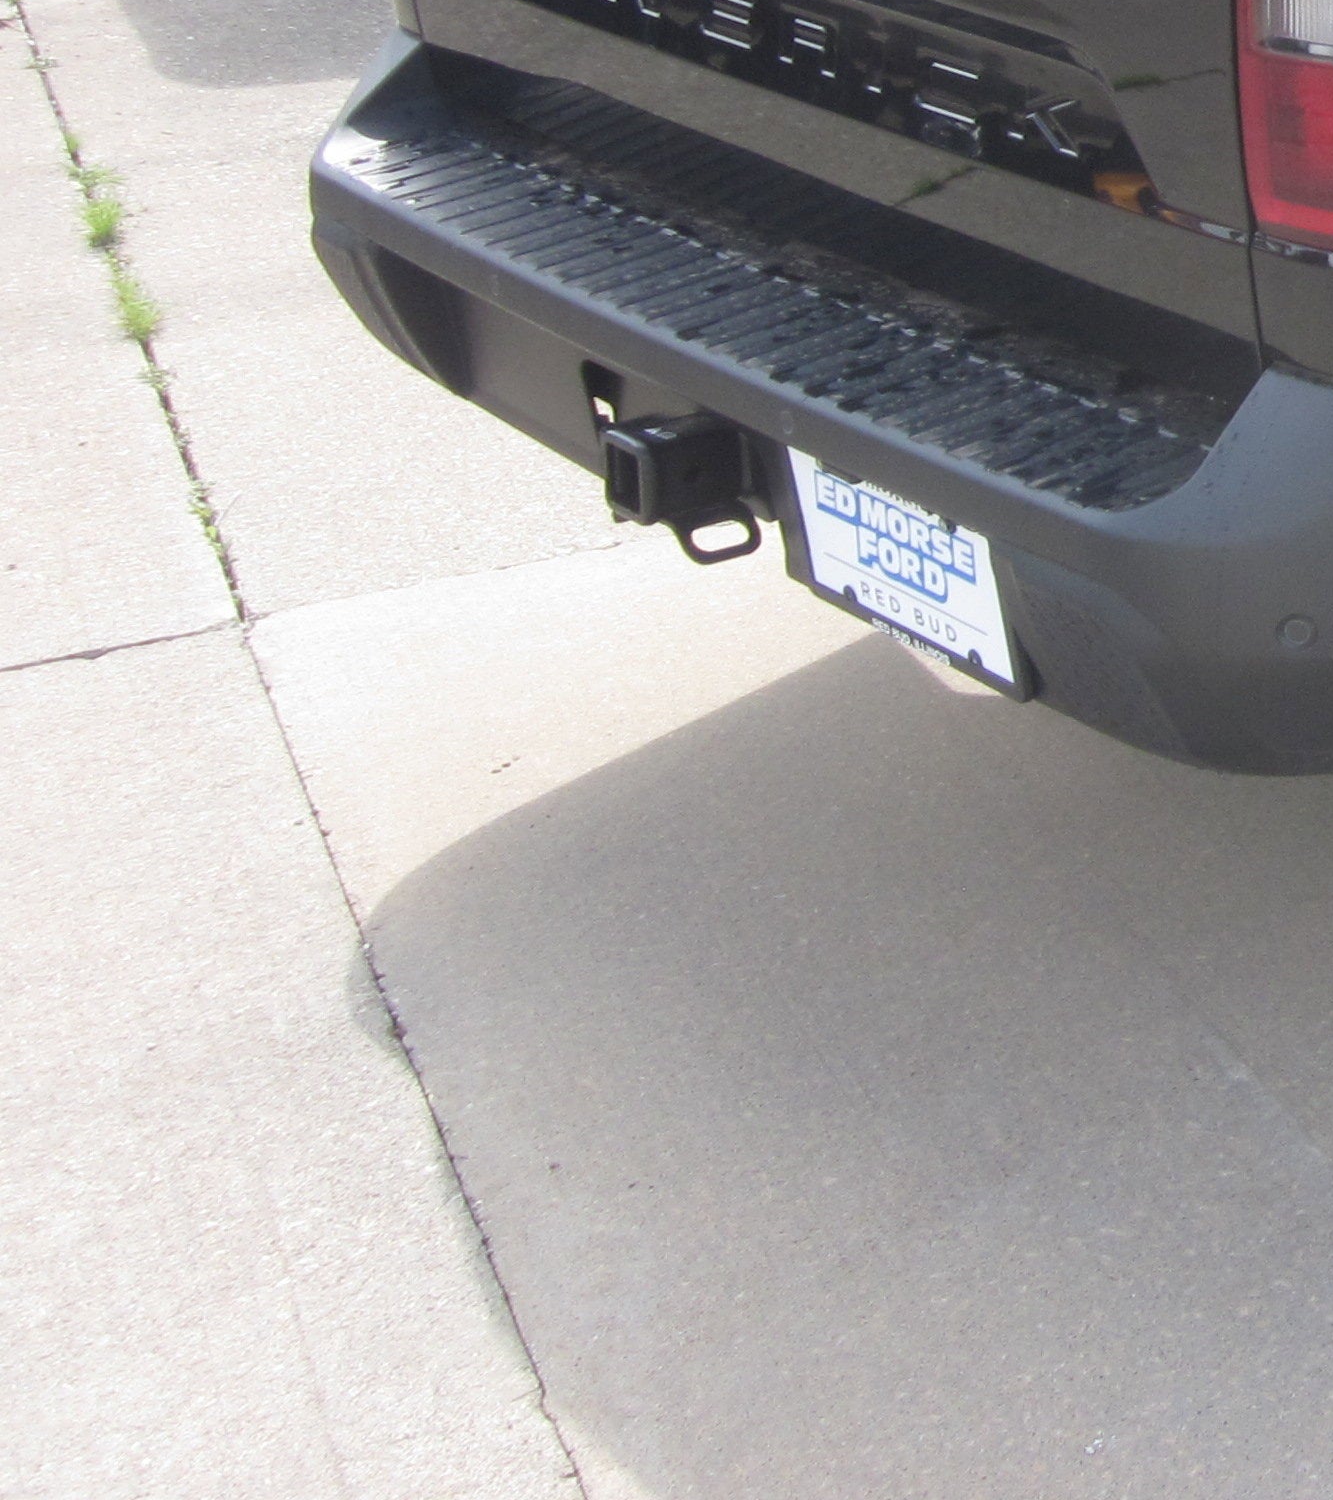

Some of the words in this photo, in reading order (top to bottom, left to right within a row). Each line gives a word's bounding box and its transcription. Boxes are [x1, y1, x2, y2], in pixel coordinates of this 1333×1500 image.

[814, 470, 858, 521] ED
[858, 489, 976, 579] MORSE
[857, 526, 948, 600] FORD
[860, 580, 901, 614] RED
[914, 608, 958, 643] BUD
